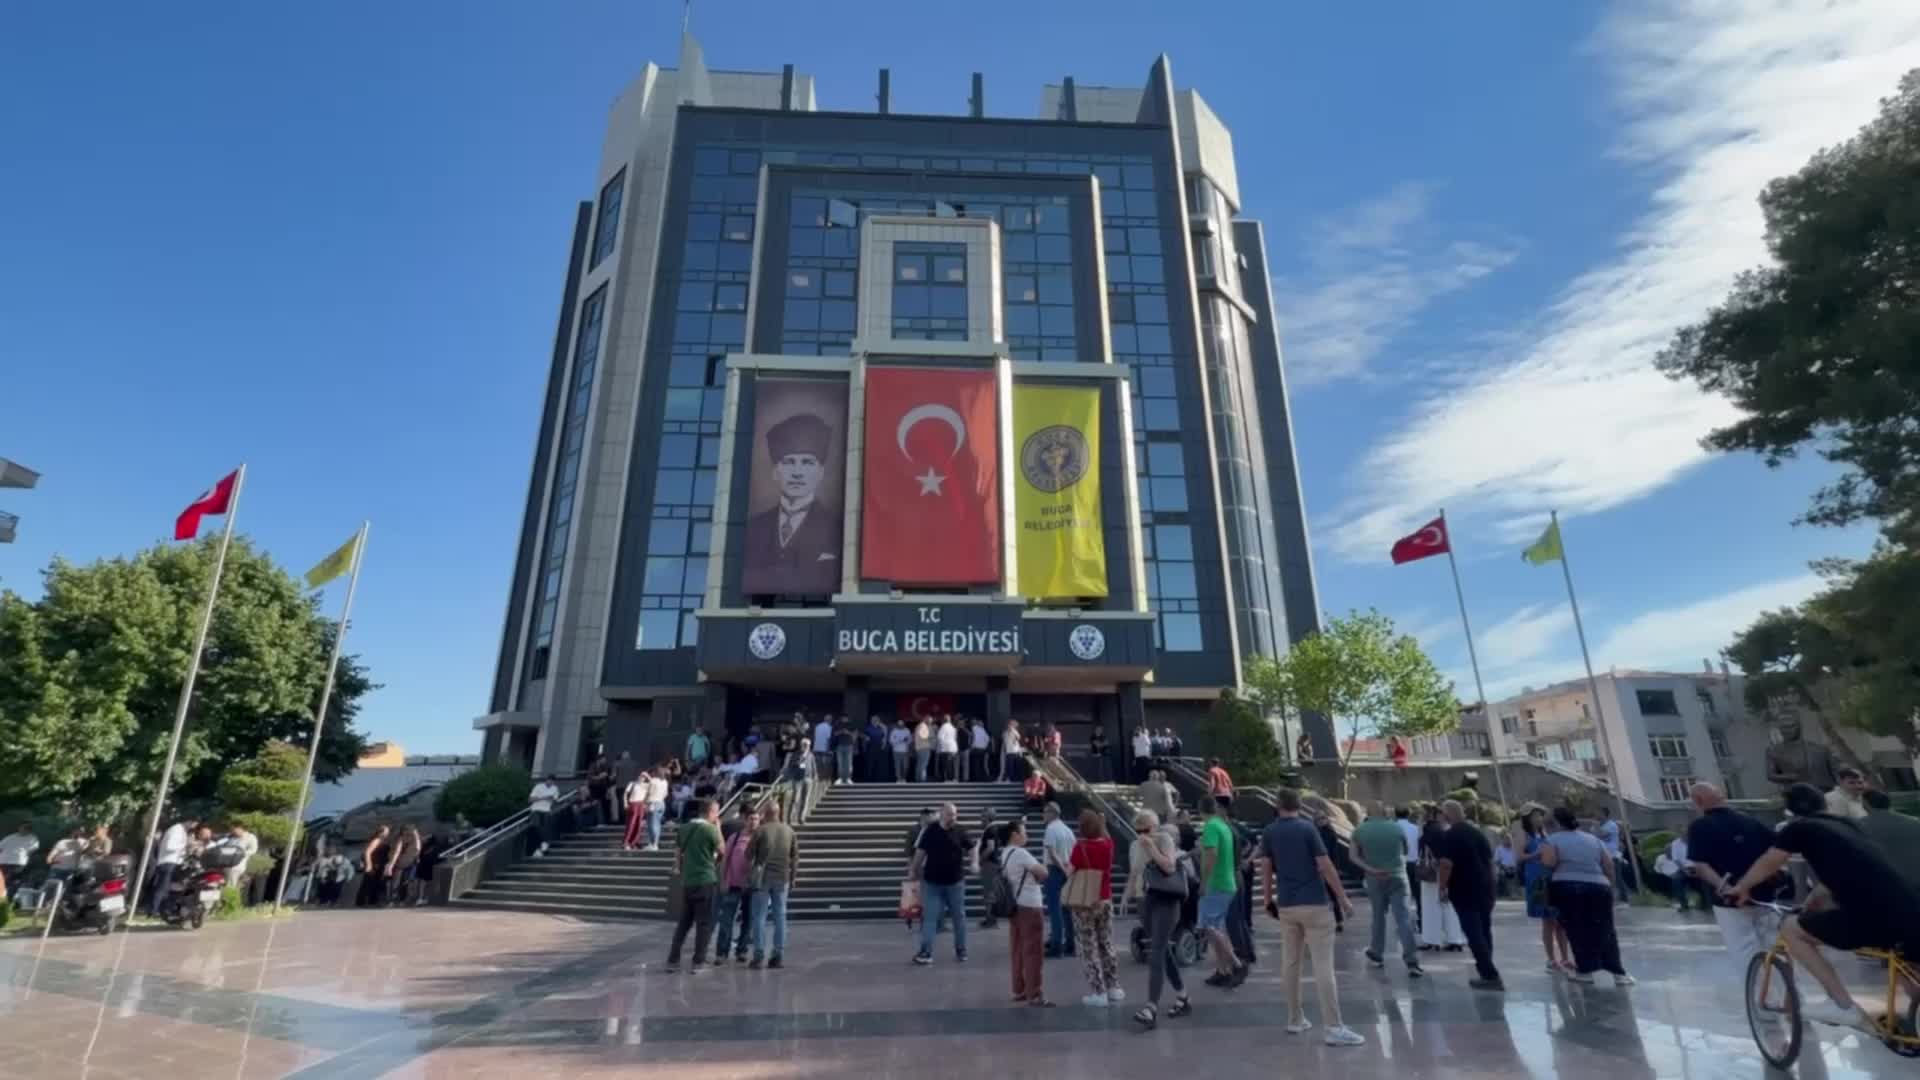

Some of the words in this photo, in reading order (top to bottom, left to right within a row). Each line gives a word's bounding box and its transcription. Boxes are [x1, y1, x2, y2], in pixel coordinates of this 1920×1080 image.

[1024, 518, 1089, 531] BELEDİY
[838, 629, 898, 652] BUCA
[904, 625, 1019, 653] BELEDİYESİ
